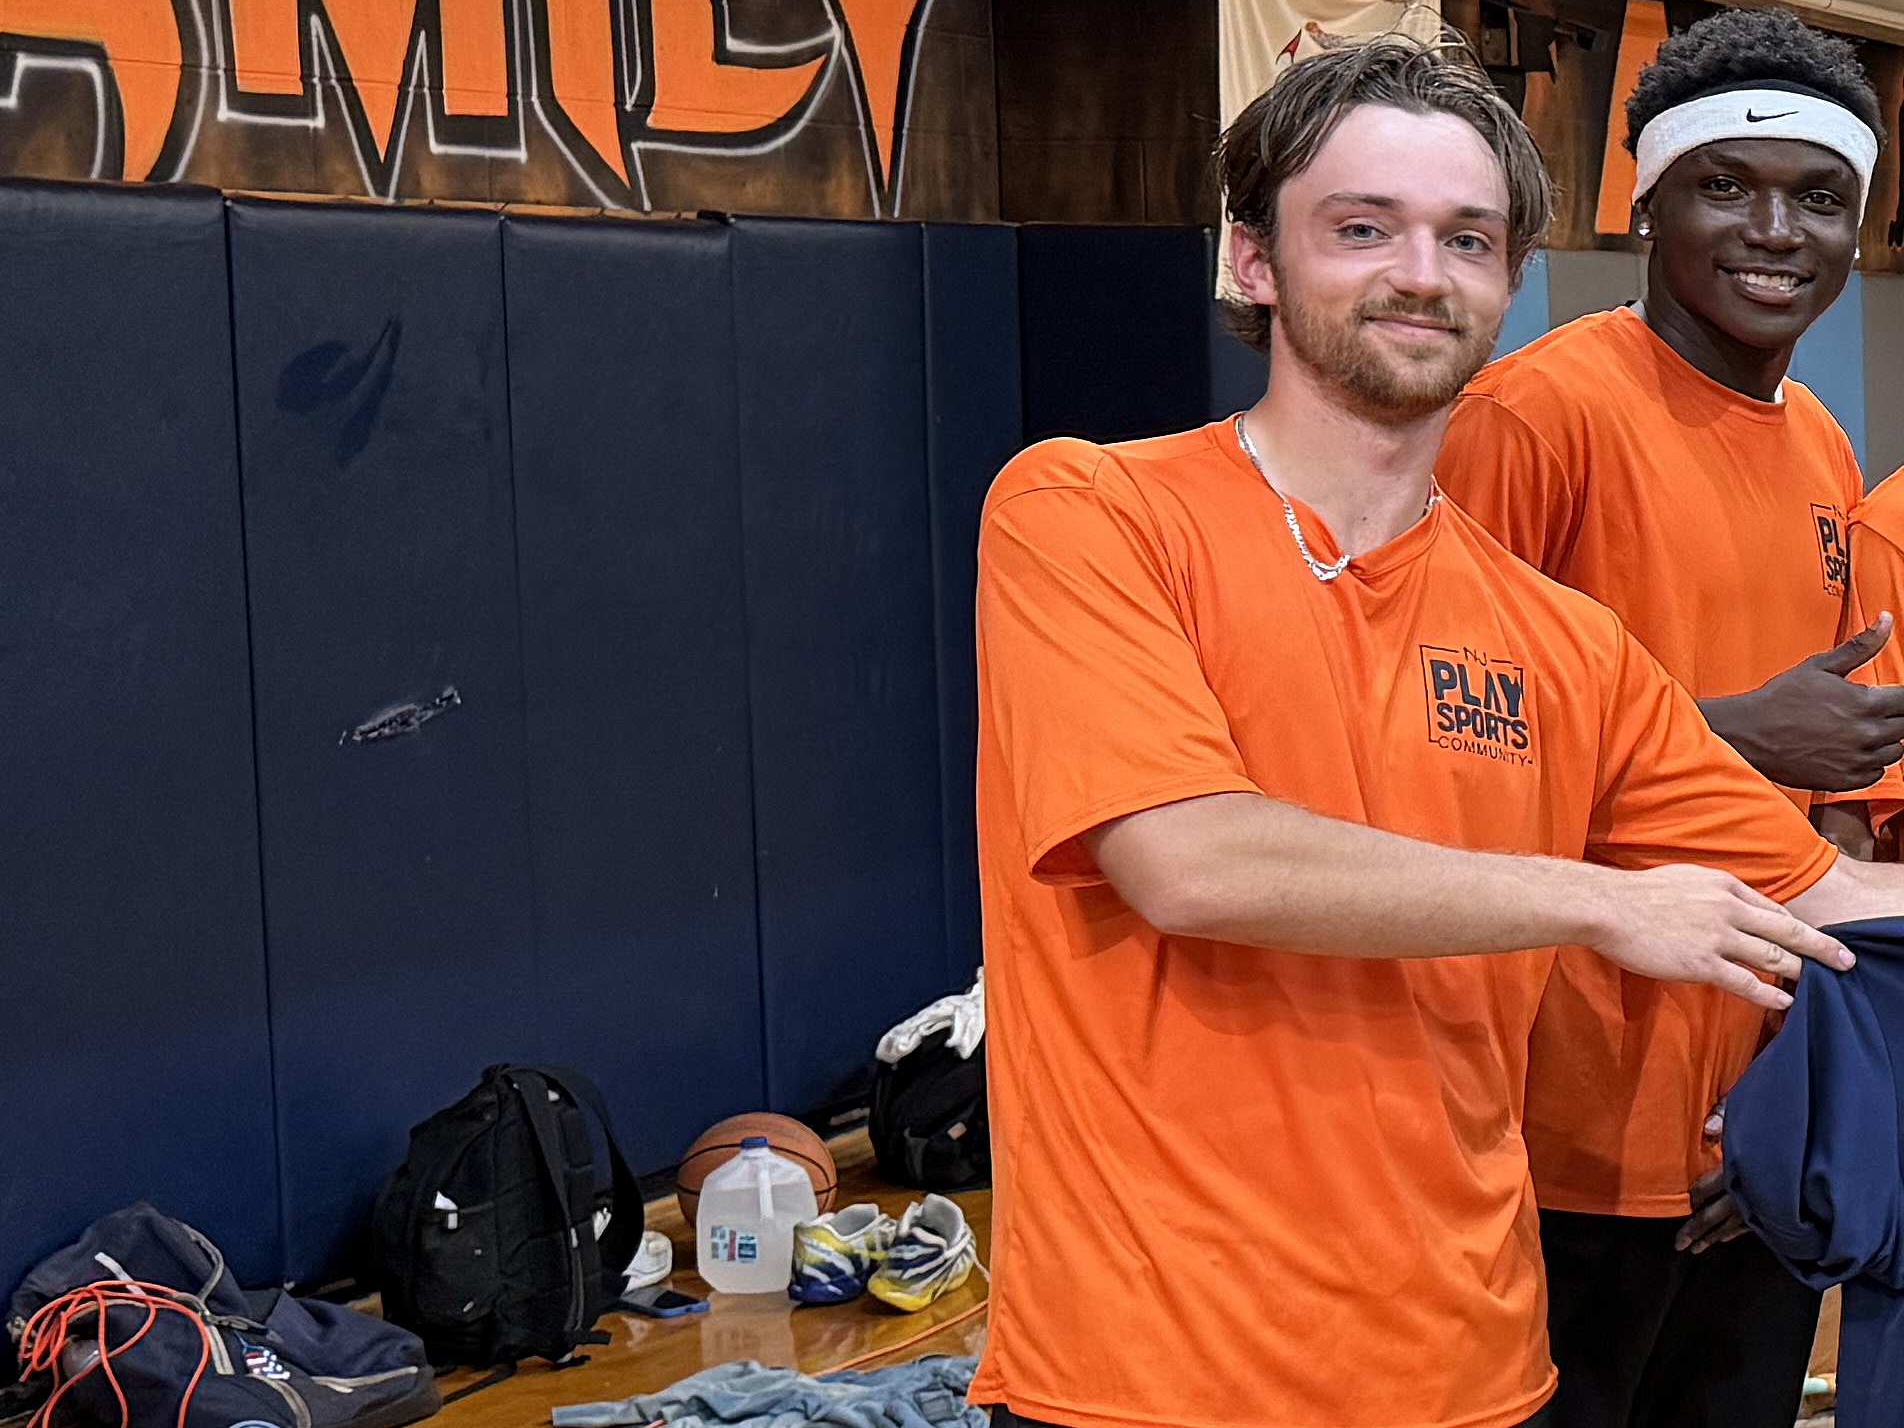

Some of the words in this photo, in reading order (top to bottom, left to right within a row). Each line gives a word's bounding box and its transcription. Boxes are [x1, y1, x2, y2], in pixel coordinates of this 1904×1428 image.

[1463, 647, 1488, 667] NJ
[1429, 659, 1522, 718] PLAY
[1436, 702, 1529, 750] SPORTS
